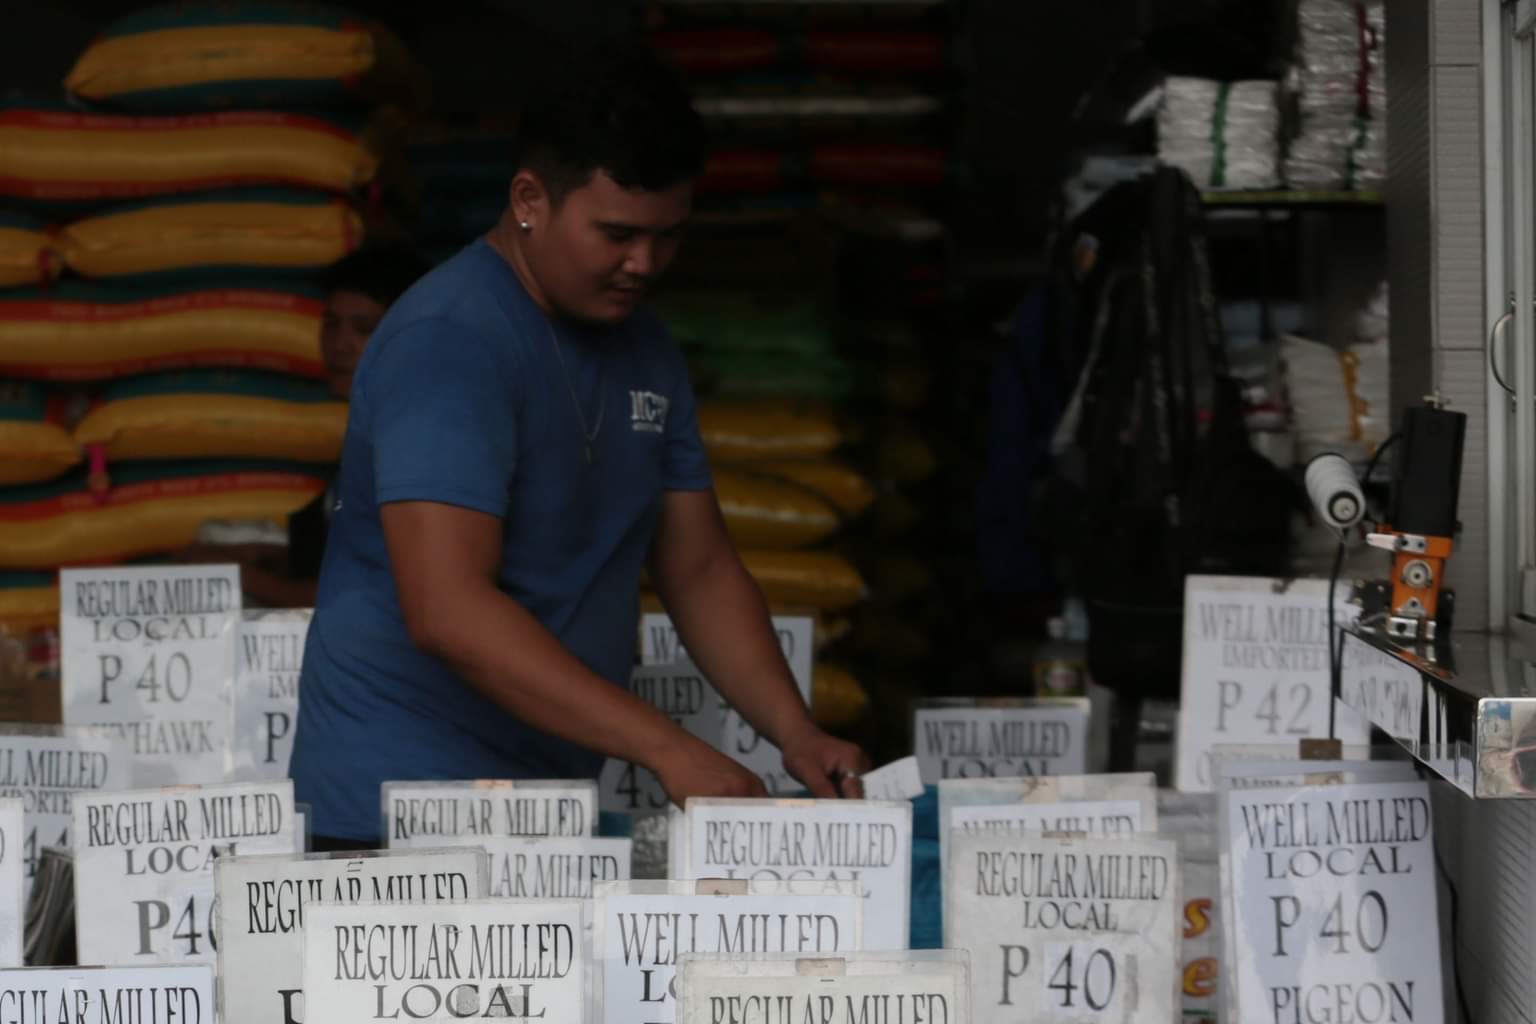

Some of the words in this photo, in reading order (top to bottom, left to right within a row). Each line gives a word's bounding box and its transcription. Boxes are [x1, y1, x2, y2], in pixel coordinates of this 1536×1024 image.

[76, 581, 158, 616] REGULAR
[163, 578, 231, 614] MILLED
[93, 617, 217, 642] LOCAL
[1200, 604, 1256, 642] WELL
[98, 654, 123, 703] P
[136, 652, 191, 702] 40
[1217, 682, 1242, 732] P
[1256, 683, 1313, 735] 42
[265, 712, 290, 763] P
[924, 722, 981, 758] WELL
[987, 722, 1070, 758] MILLED
[24, 748, 108, 789] MILLED
[88, 800, 188, 847] REGULAR
[200, 793, 281, 841] MILLED
[395, 799, 492, 839] REGULAR
[508, 799, 582, 836] MILLED
[1242, 803, 1319, 849] WELL
[1327, 798, 1429, 845] MILLED
[706, 821, 805, 867] REGULAR
[814, 822, 897, 868] MILLED
[1266, 847, 1411, 879] LOCAL
[977, 852, 1079, 898] REGULAR
[1086, 853, 1167, 900] MILLED
[1023, 902, 1117, 931] LOCAL
[1270, 896, 1300, 956] P
[1319, 890, 1388, 953] 40
[335, 926, 460, 983] REGULAR
[468, 923, 573, 980] MILLED
[374, 984, 546, 1019] LOCAL
[999, 945, 1029, 1005] P
[1047, 947, 1116, 1011] 40
